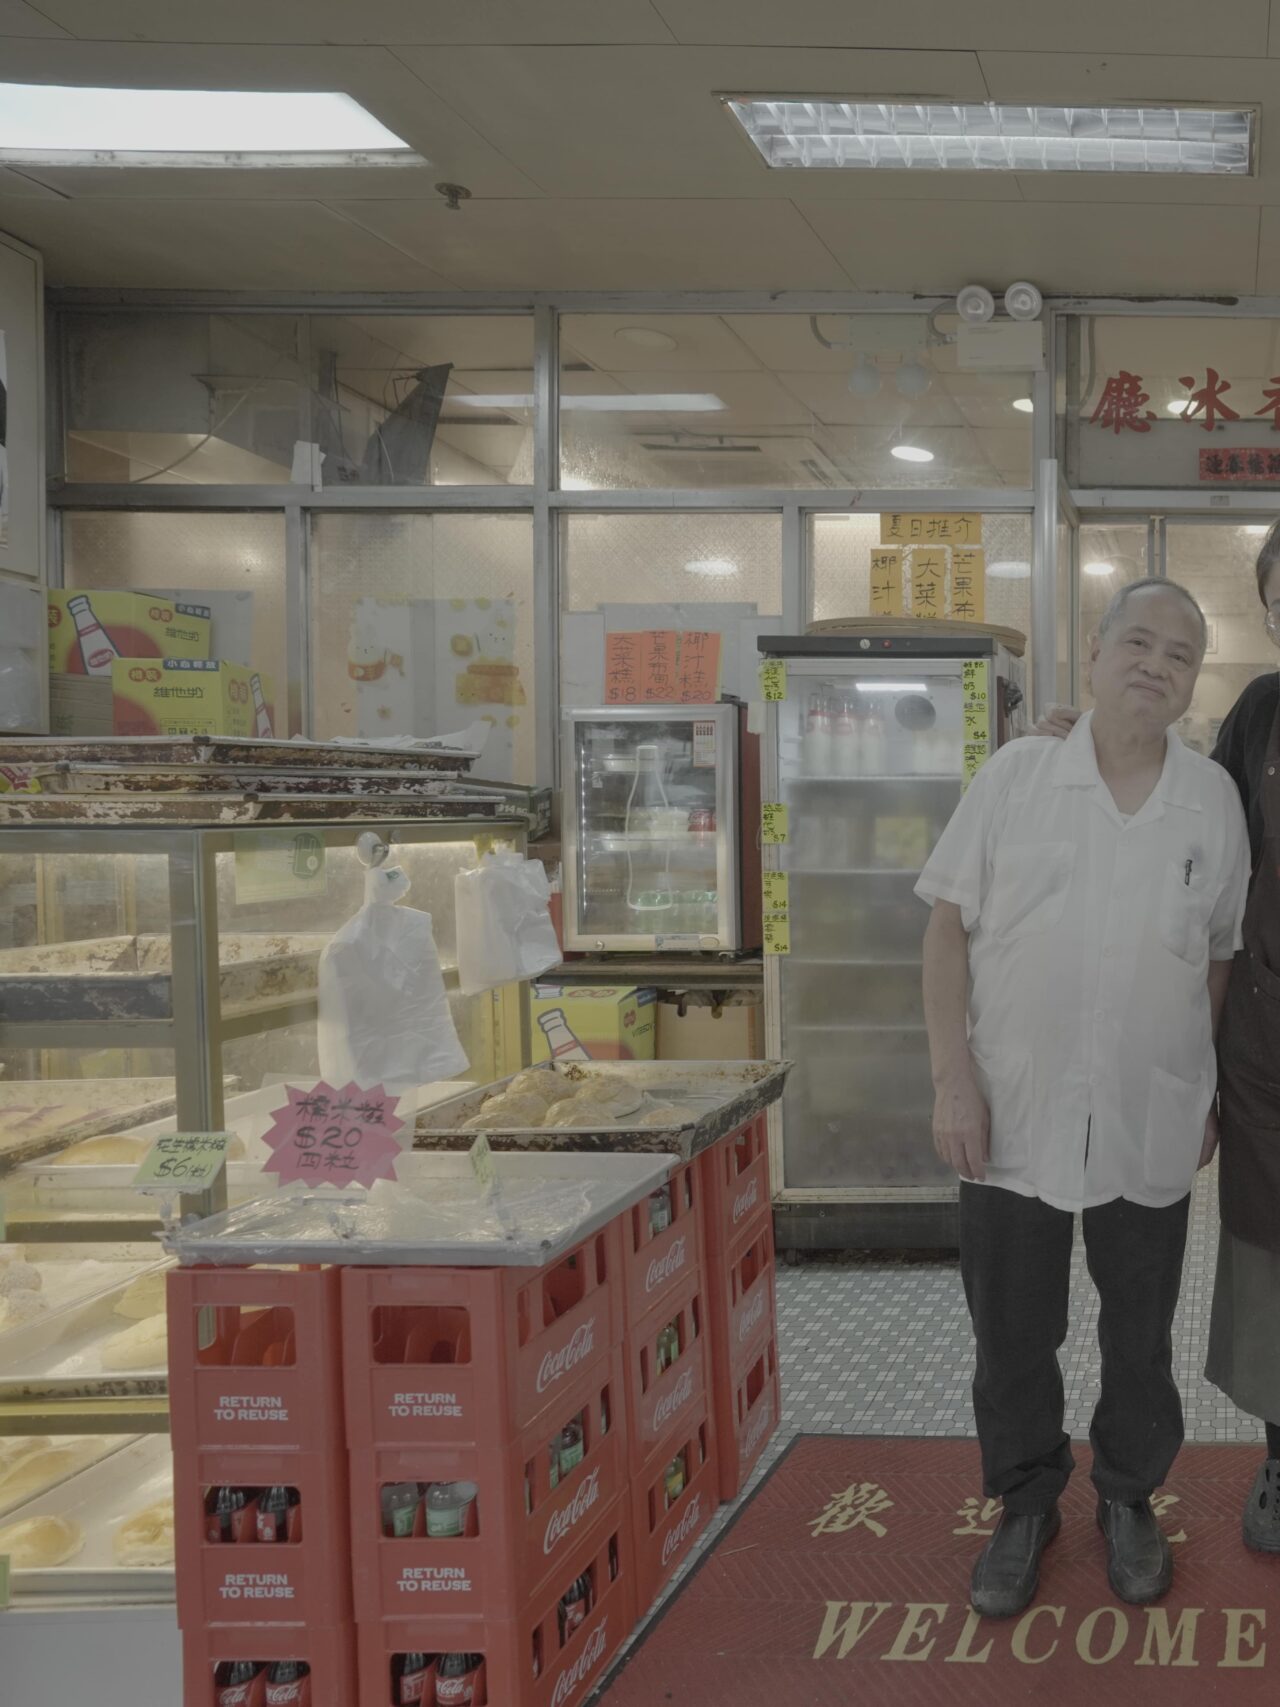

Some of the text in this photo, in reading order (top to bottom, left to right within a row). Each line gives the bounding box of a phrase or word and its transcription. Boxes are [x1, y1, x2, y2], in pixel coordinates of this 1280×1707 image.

[886, 514, 974, 543] 夏日推介
[871, 555, 897, 616] 椰汁
[153, 687, 205, 698] 維他奶
[294, 1125, 362, 1149] $20
[296, 1151, 359, 1172] 四粒
[536, 1317, 596, 1393] Coca-Cola
[219, 1396, 282, 1407] RETURN
[394, 1392, 457, 1404] RETURN
[214, 1409, 289, 1421] TO REUSE
[388, 1405, 463, 1417] TO REUSE
[225, 1573, 288, 1585] RETURN
[403, 1568, 465, 1580] RETURN
[397, 1580, 472, 1591] TO REUSE
[220, 1586, 295, 1599] TO REUSE
[811, 1600, 1266, 1667] WELCOME
